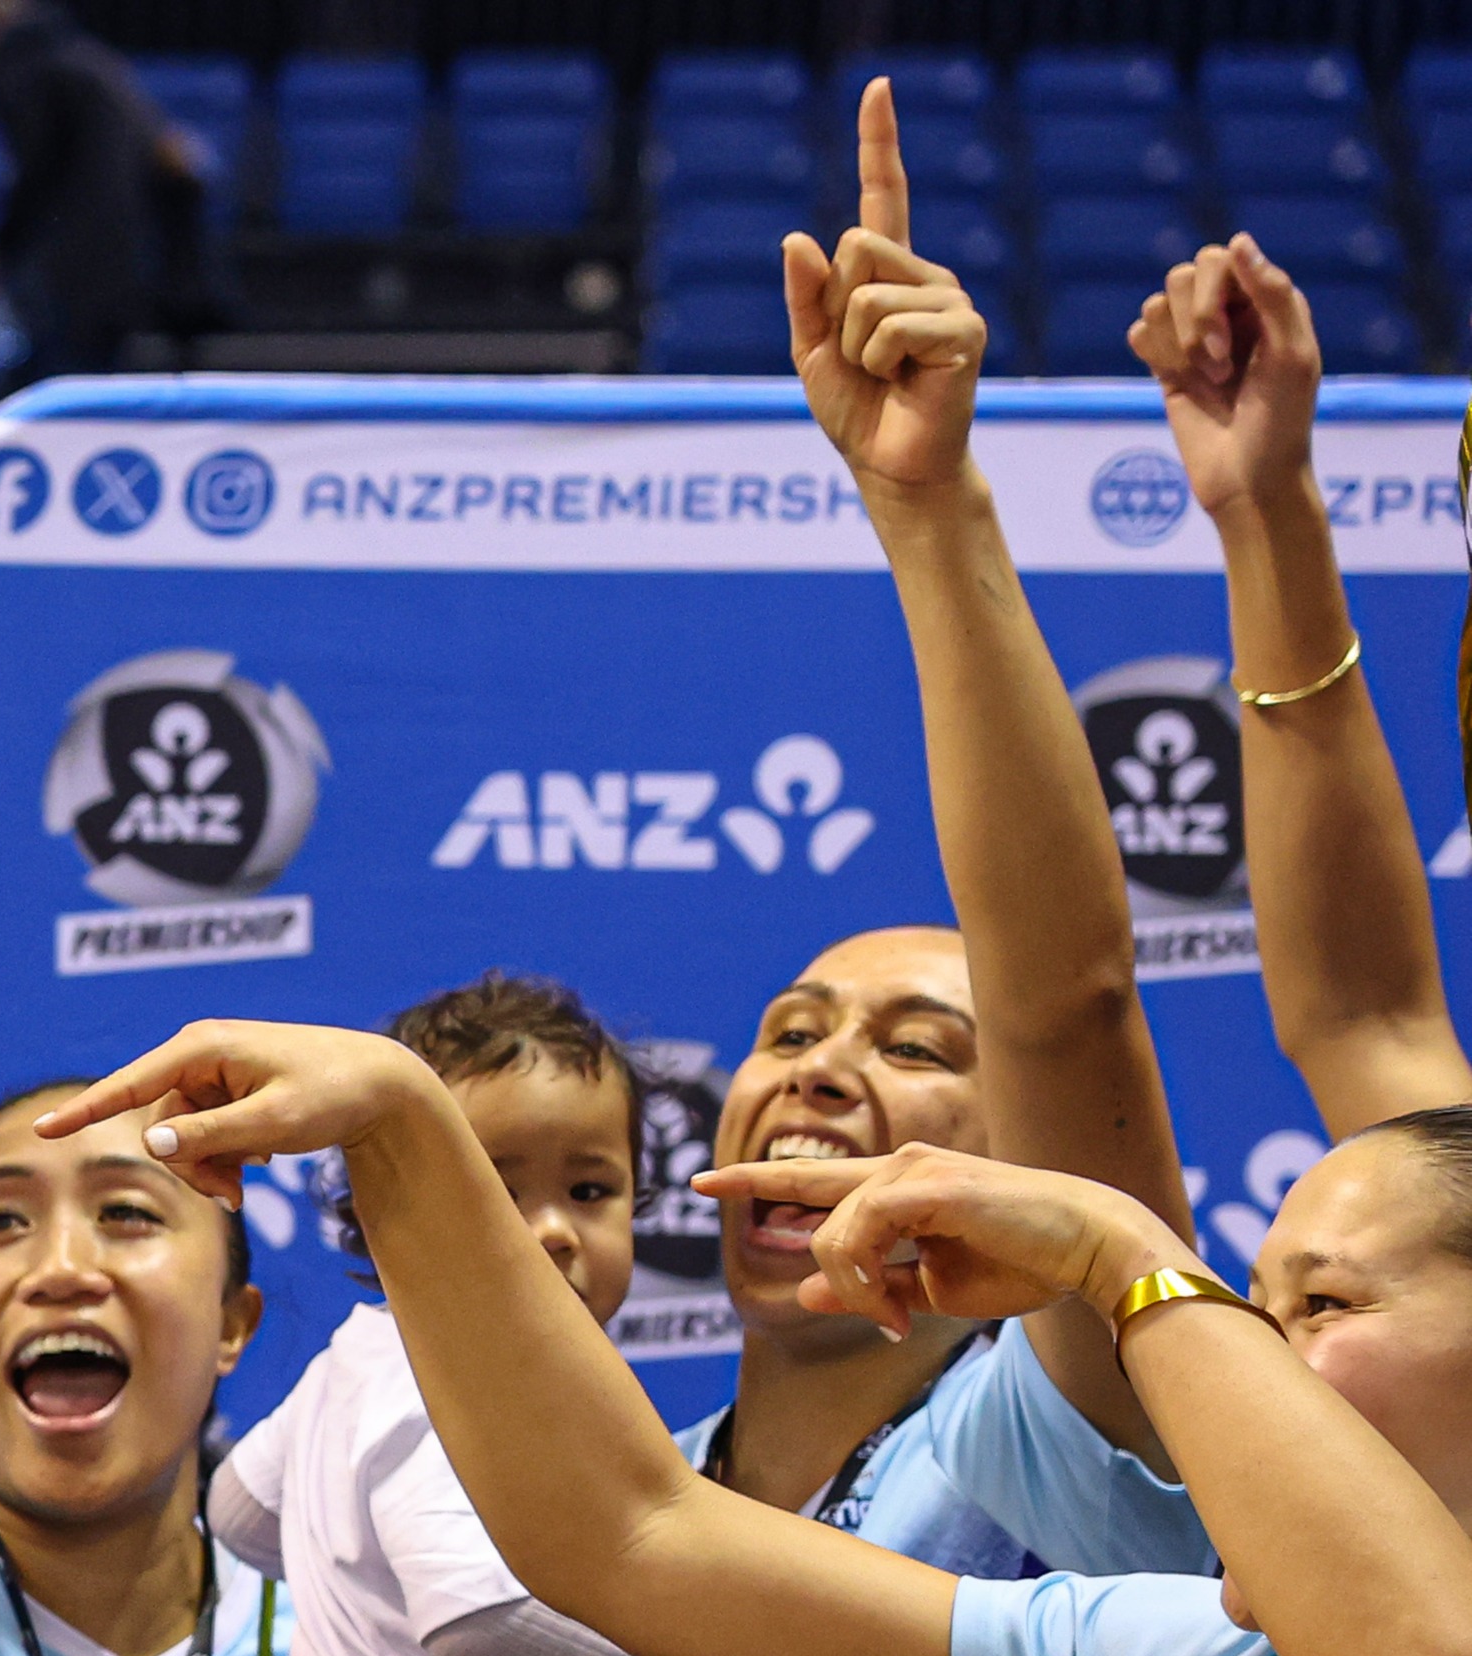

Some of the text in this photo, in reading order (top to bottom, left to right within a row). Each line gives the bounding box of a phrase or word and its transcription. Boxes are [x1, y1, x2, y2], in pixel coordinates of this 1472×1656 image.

[303, 472, 866, 524] ANZPREMIERSH
[111, 794, 242, 845] ANZ
[431, 770, 718, 871] ANZ
